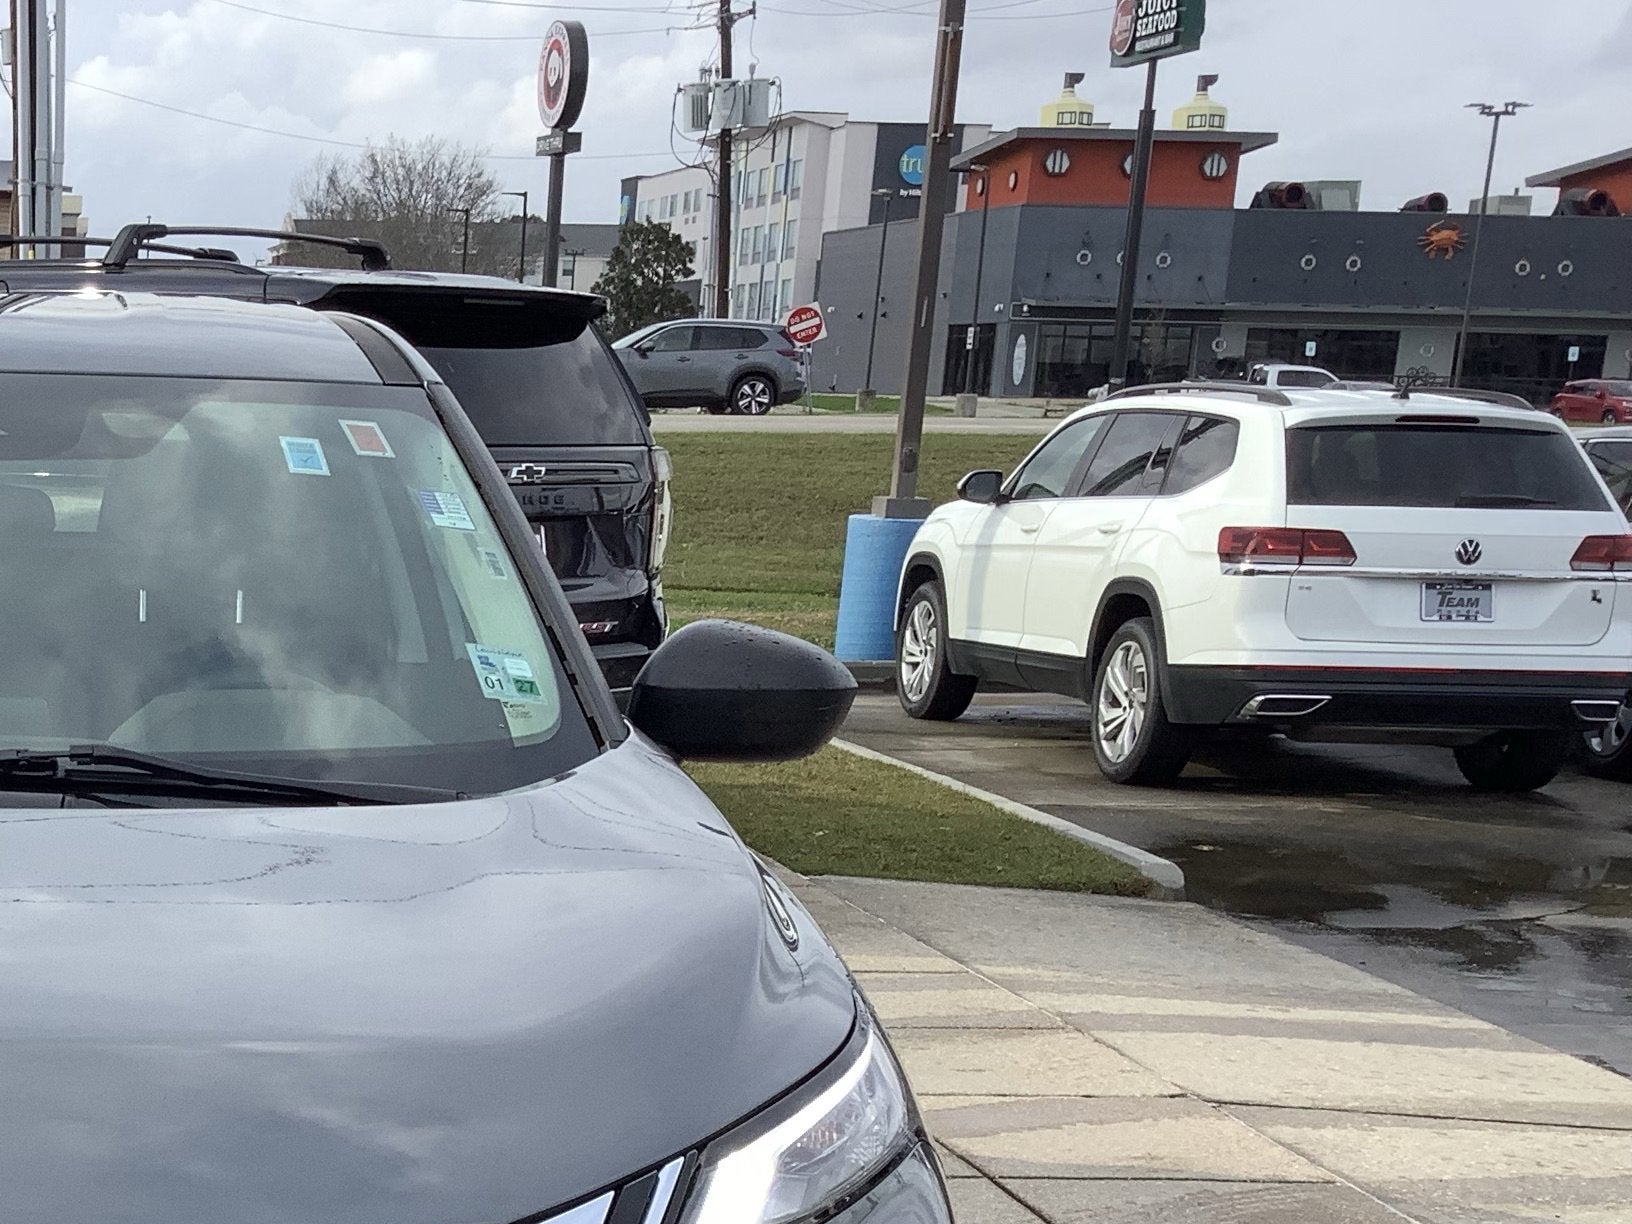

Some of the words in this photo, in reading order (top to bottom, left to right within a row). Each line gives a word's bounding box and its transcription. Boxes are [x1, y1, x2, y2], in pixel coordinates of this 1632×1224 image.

[1136, 10, 1177, 38] SEAFOOD
[790, 316, 800, 325] DO
[801, 311, 815, 321] NOT
[797, 327, 818, 339] ENTER
[484, 676, 504, 691] 01
[515, 680, 534, 694] 27
